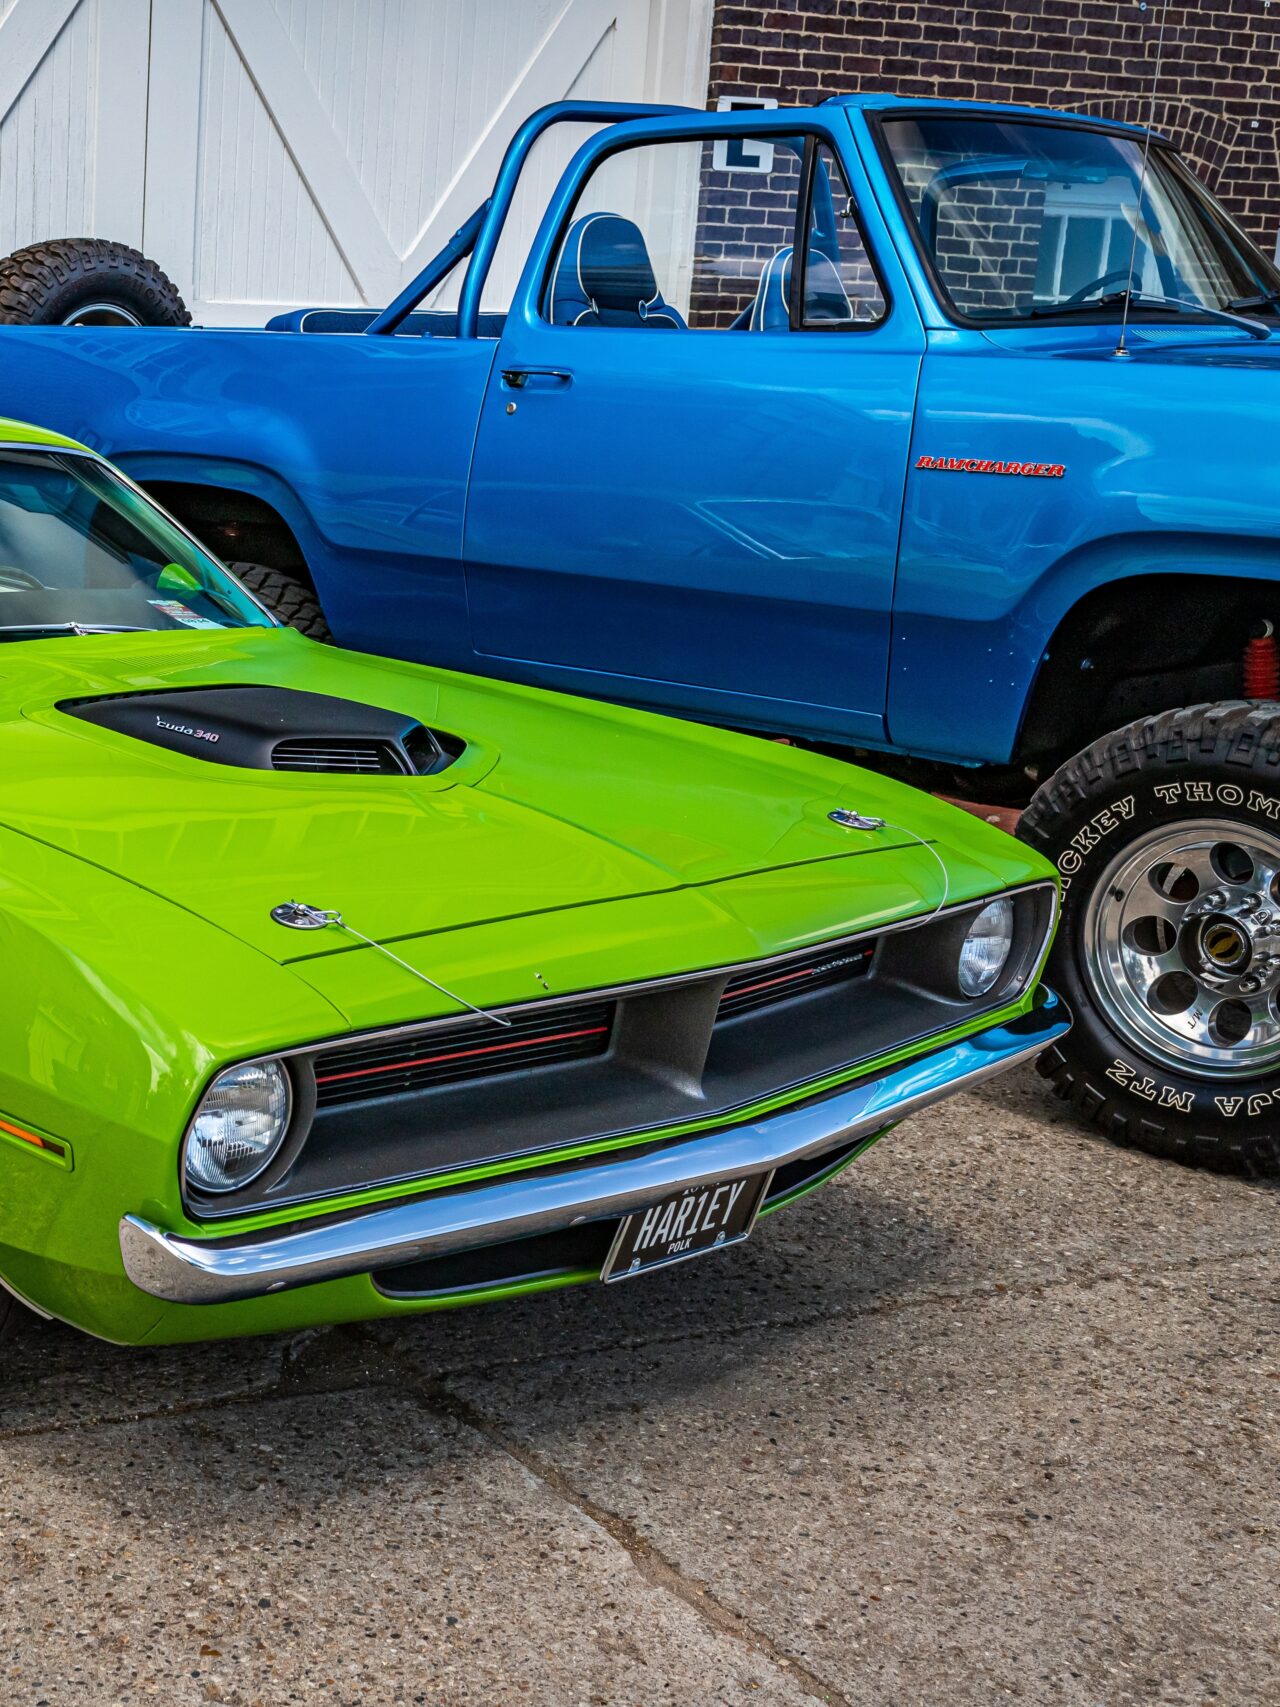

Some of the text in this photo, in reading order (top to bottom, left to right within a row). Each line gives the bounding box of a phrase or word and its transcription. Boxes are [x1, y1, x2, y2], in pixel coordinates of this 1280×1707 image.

[915, 456, 1065, 477] RAMCHARGER
[194, 729, 220, 743] 340
[1105, 1058, 1196, 1113] MTZ
[666, 1237, 693, 1255] POLK
